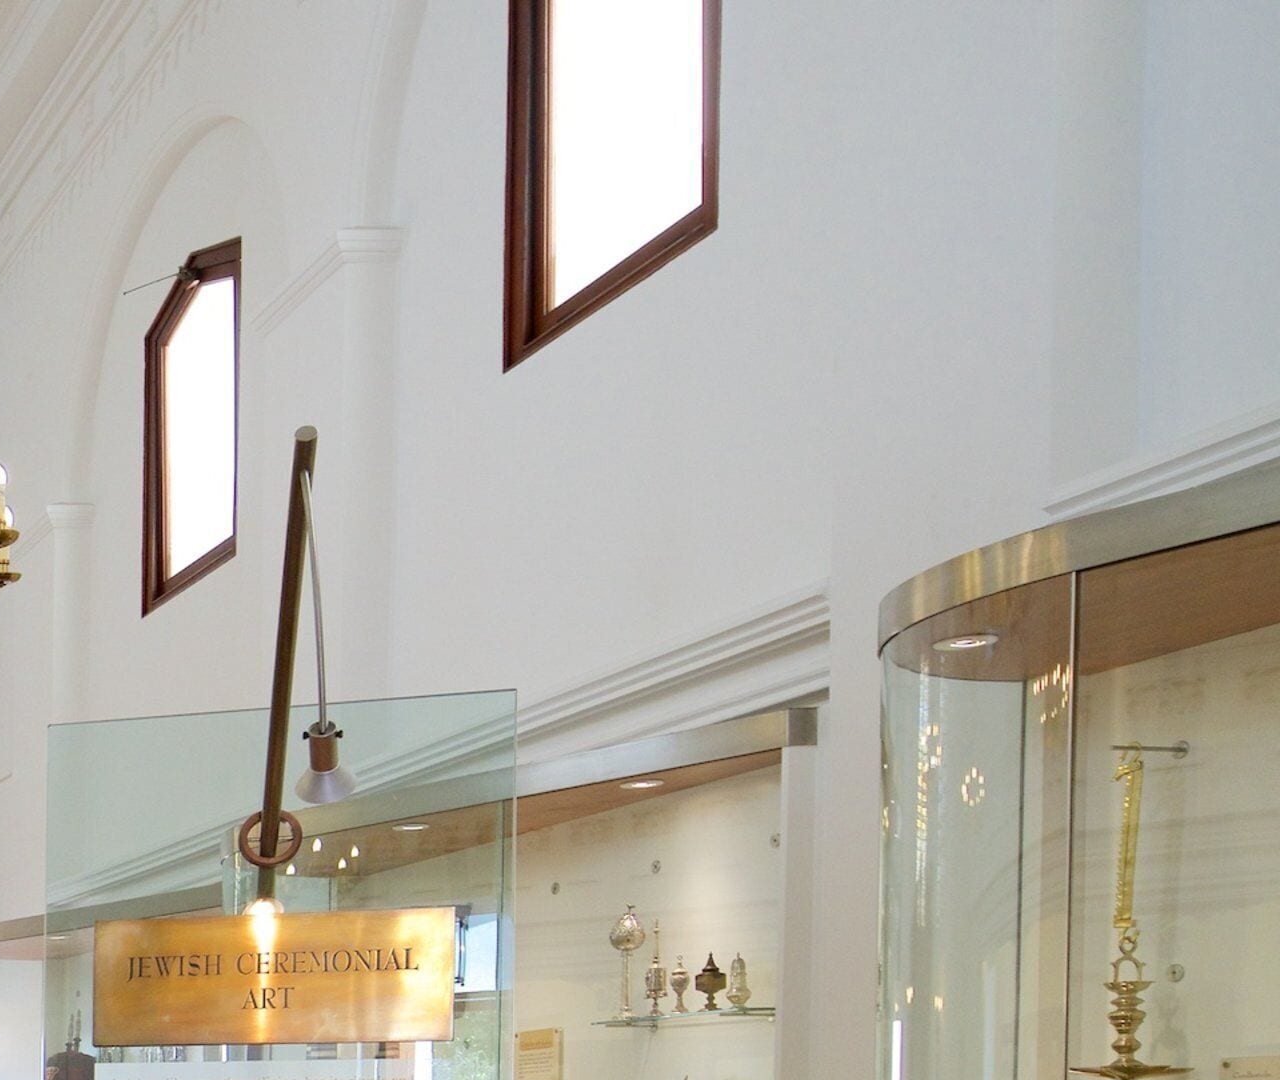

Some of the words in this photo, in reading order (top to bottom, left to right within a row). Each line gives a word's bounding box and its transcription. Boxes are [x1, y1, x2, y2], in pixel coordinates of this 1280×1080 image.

[127, 954, 222, 983] JEWISH
[236, 947, 420, 975] CEREMONIAL
[240, 986, 295, 1010] ART
